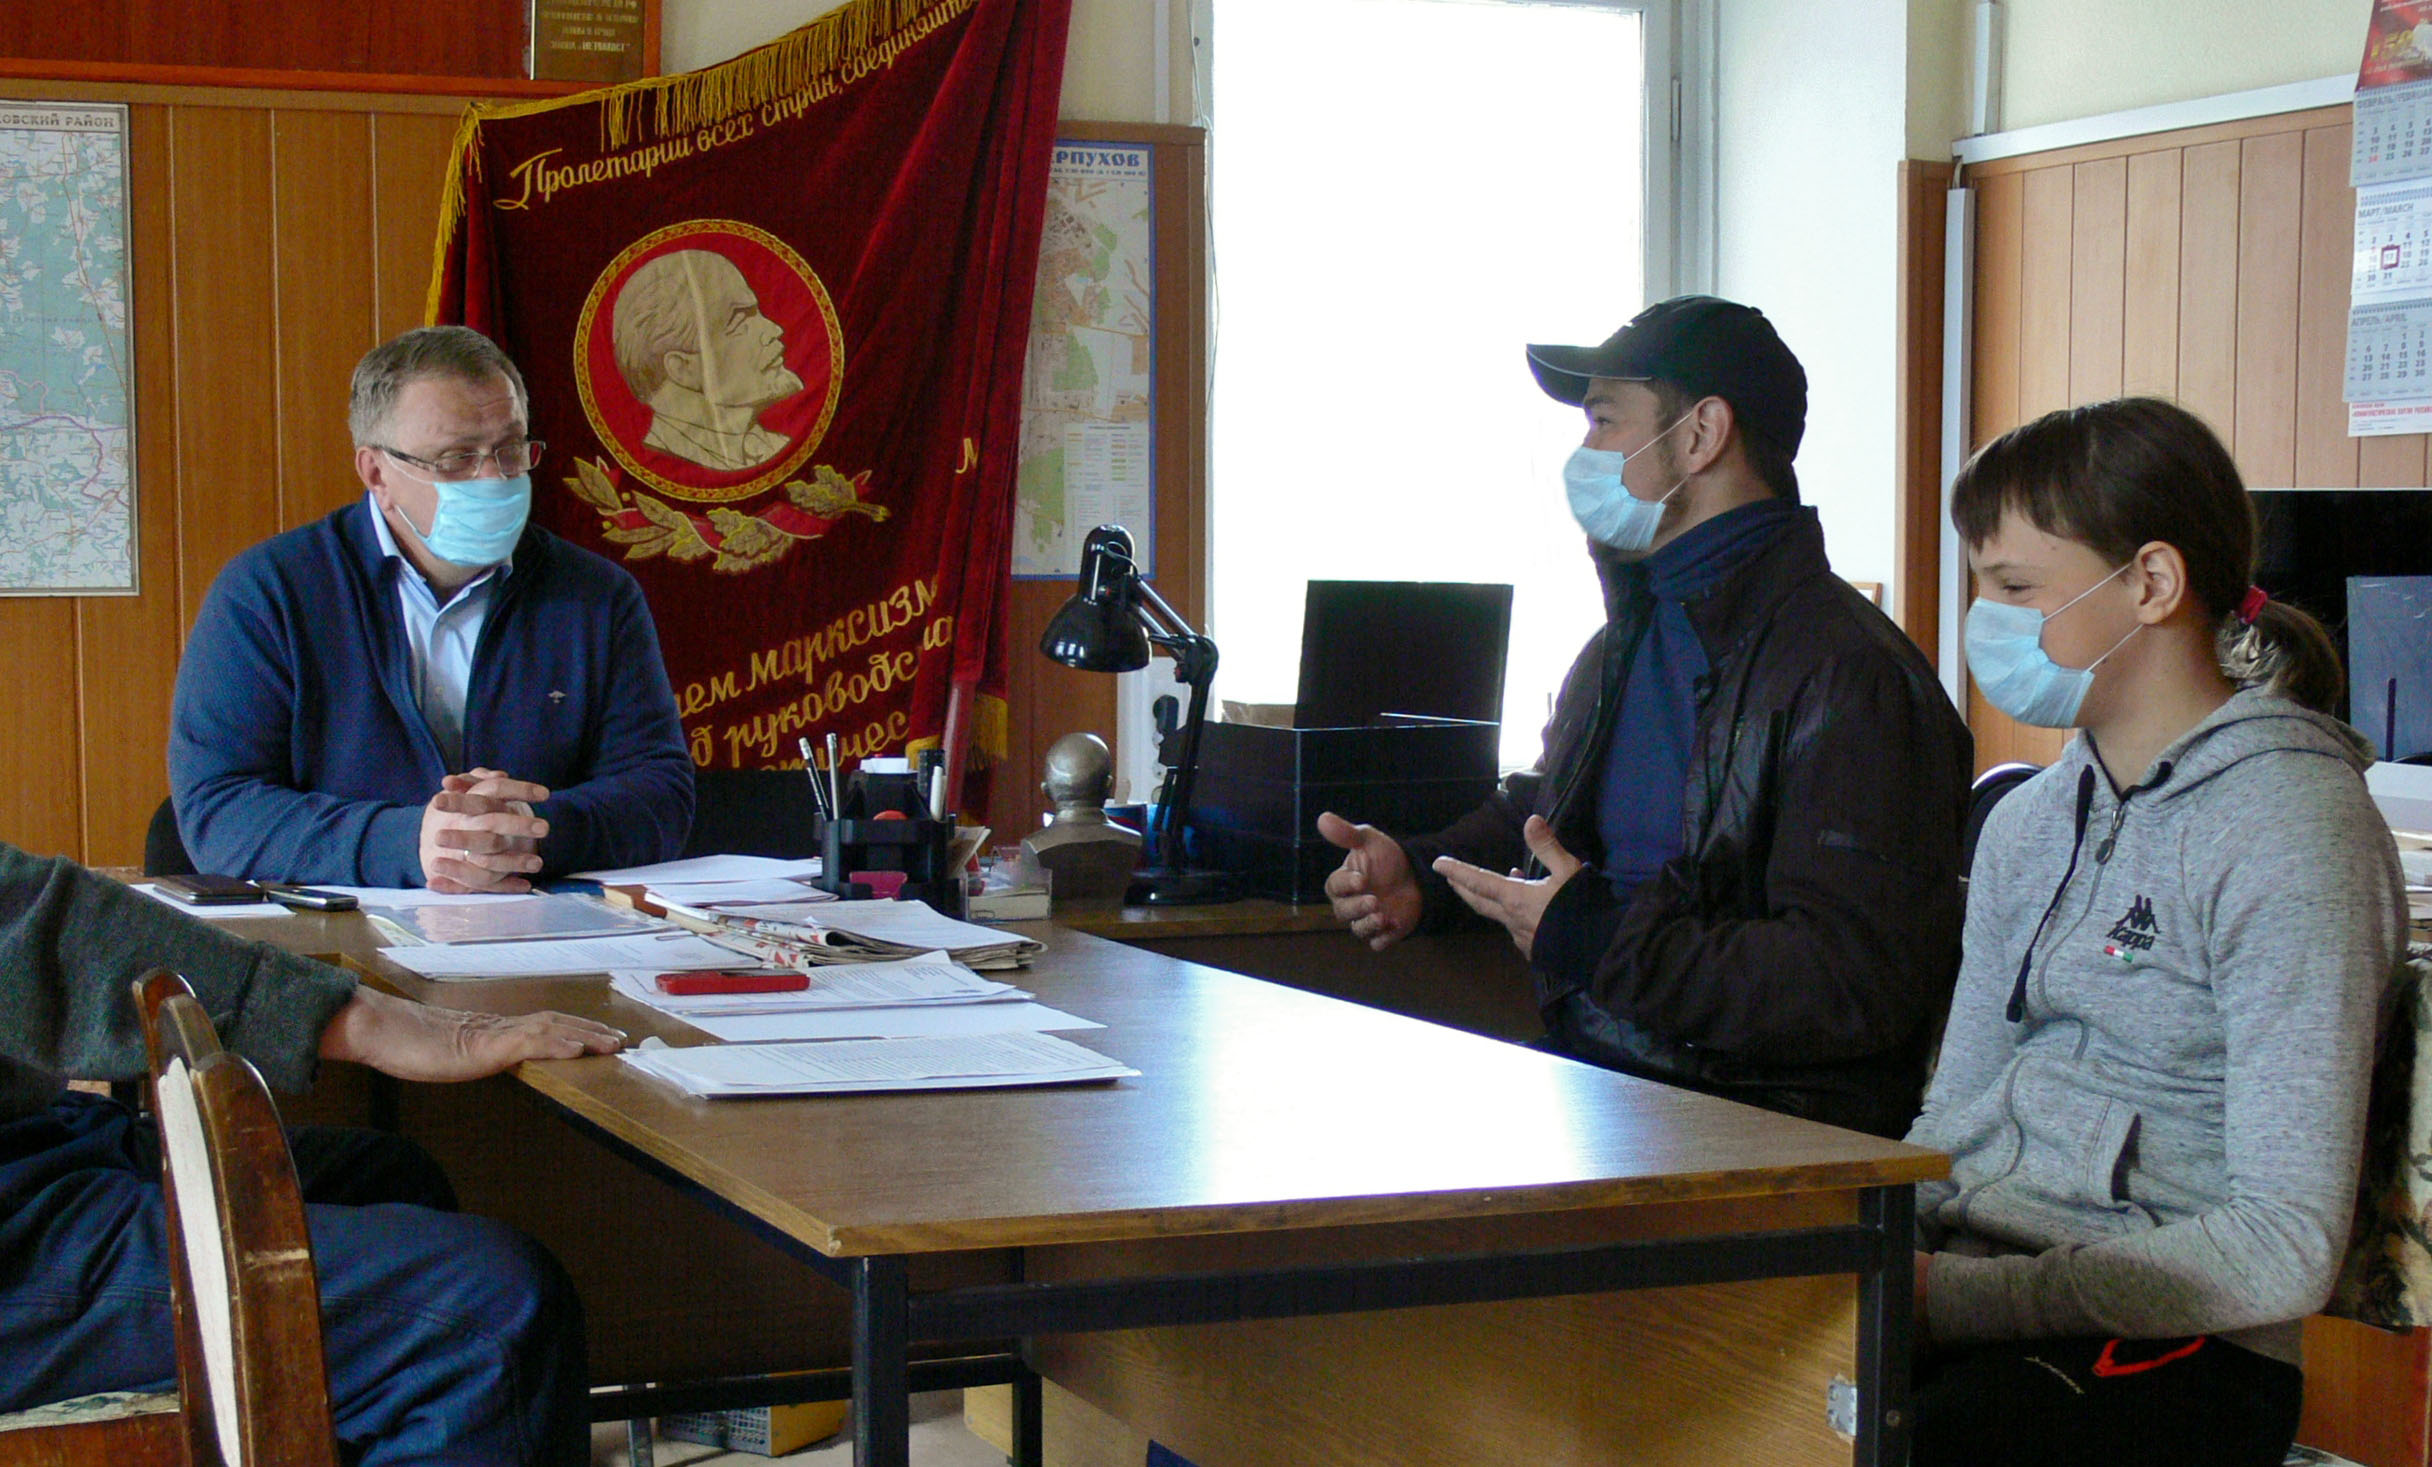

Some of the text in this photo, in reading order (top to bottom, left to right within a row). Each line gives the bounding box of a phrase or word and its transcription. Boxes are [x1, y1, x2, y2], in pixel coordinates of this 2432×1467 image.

[0, 112, 115, 127] ОВСКИЙ РАЙОН
[493, 137, 694, 210] Пролетарии
[697, 113, 754, 152] всех
[1053, 150, 1140, 168] РПУХОВ
